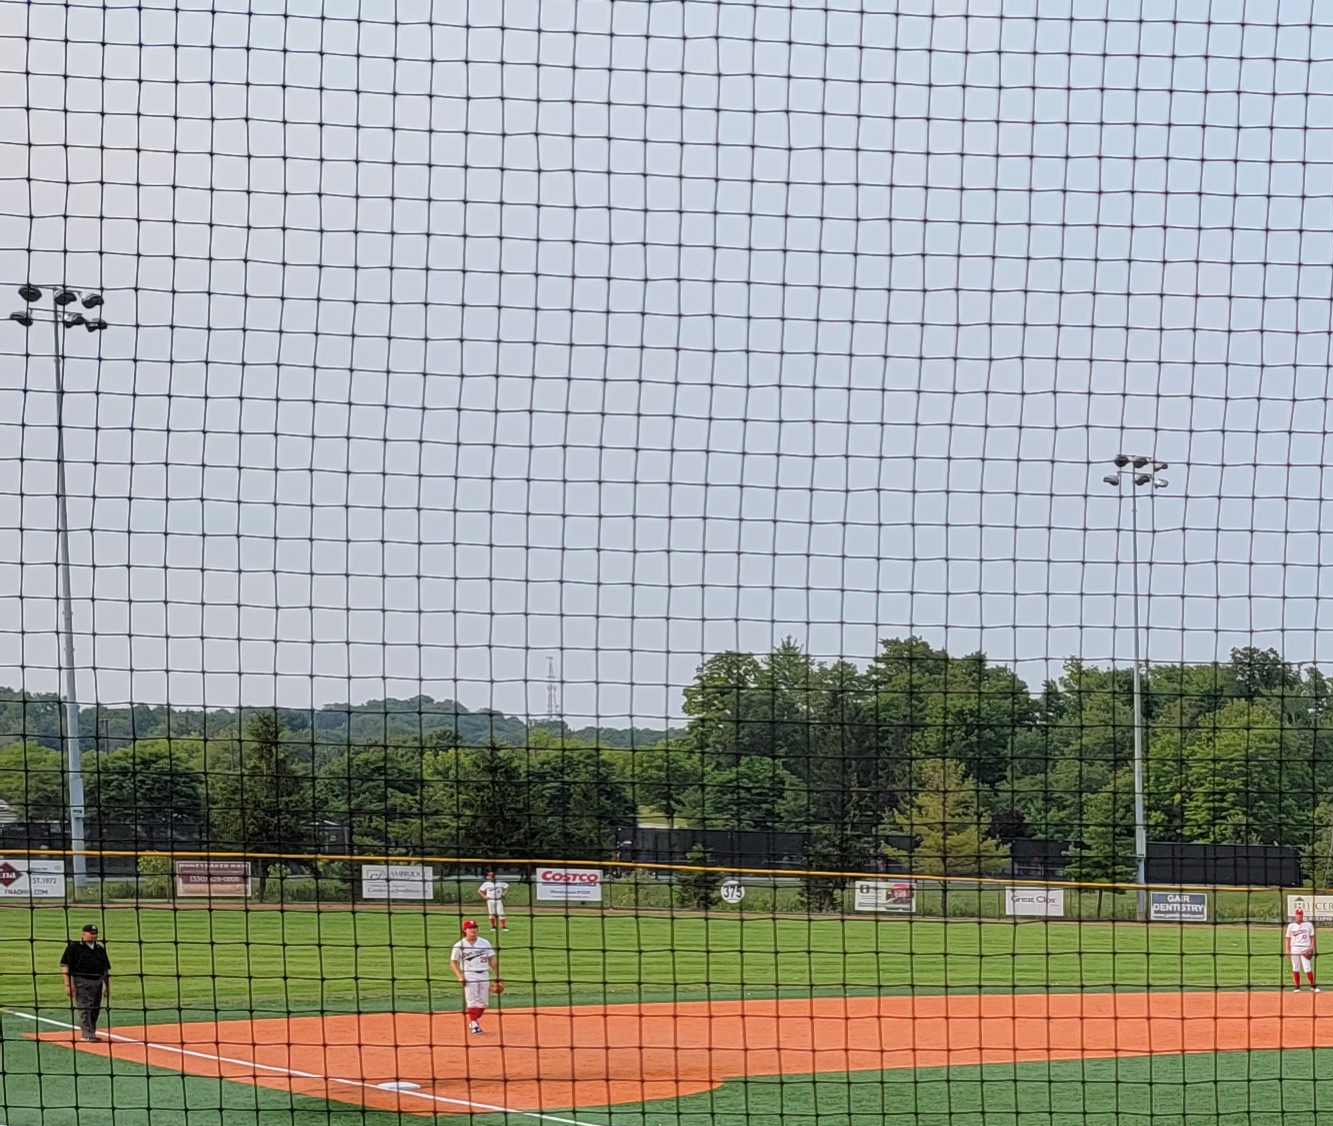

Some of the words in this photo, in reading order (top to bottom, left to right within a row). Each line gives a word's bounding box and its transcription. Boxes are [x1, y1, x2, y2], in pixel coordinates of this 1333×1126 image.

[541, 870, 599, 882] COSTCO
[723, 885, 743, 898] 375
[1153, 903, 1204, 912] DENTISTRY
